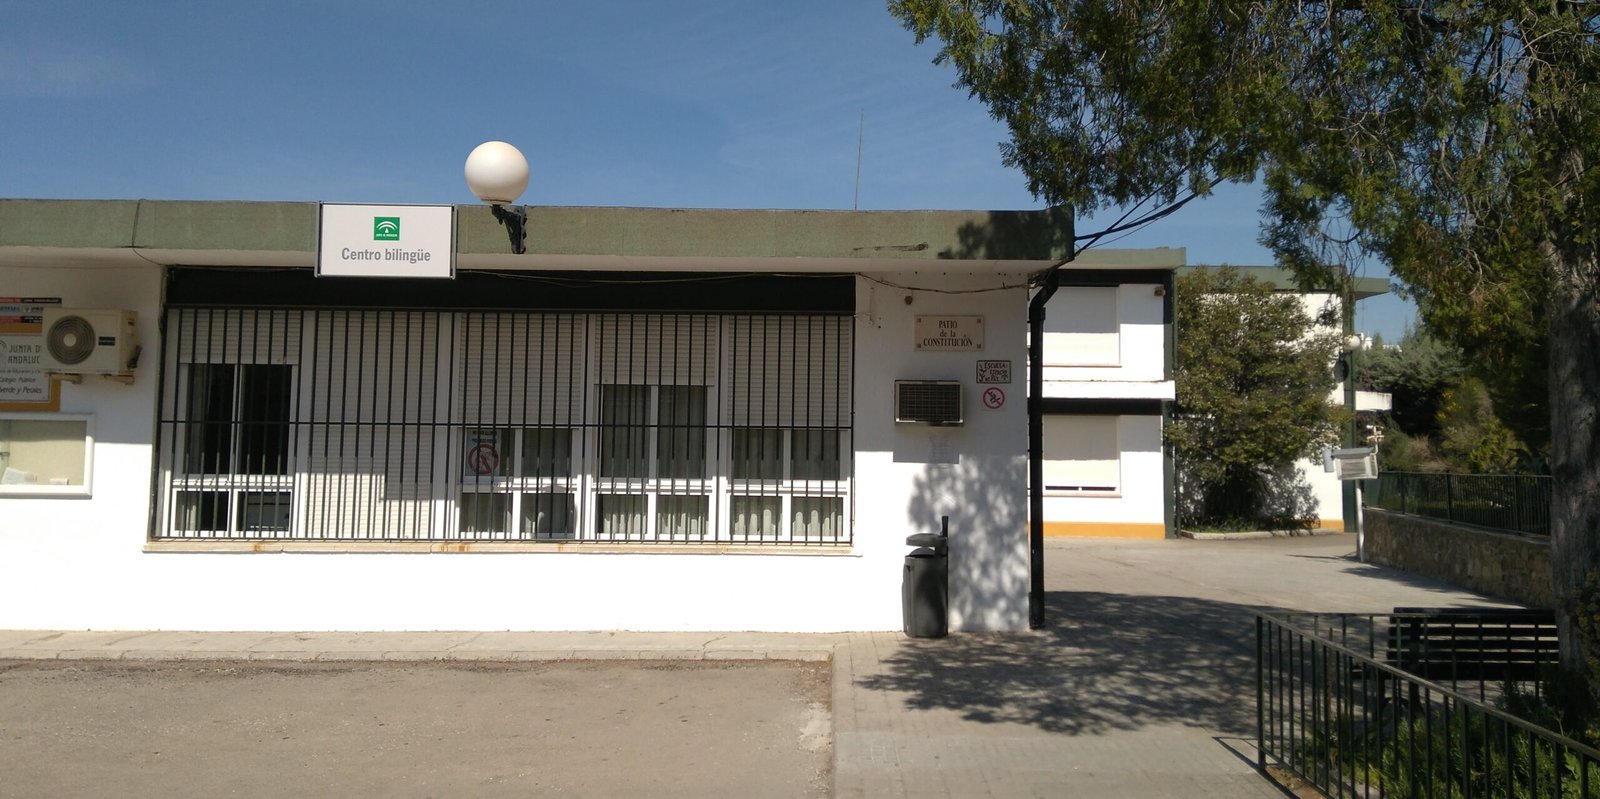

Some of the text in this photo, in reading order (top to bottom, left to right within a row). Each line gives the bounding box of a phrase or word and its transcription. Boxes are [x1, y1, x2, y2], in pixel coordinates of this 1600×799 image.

[341, 247, 431, 264] Centro bilingüe
[938, 320, 958, 329] PATIO
[923, 334, 973, 347] CONSTITUCIÓN
[9, 344, 32, 353] JUNTA
[8, 355, 40, 364] ANDALUC
